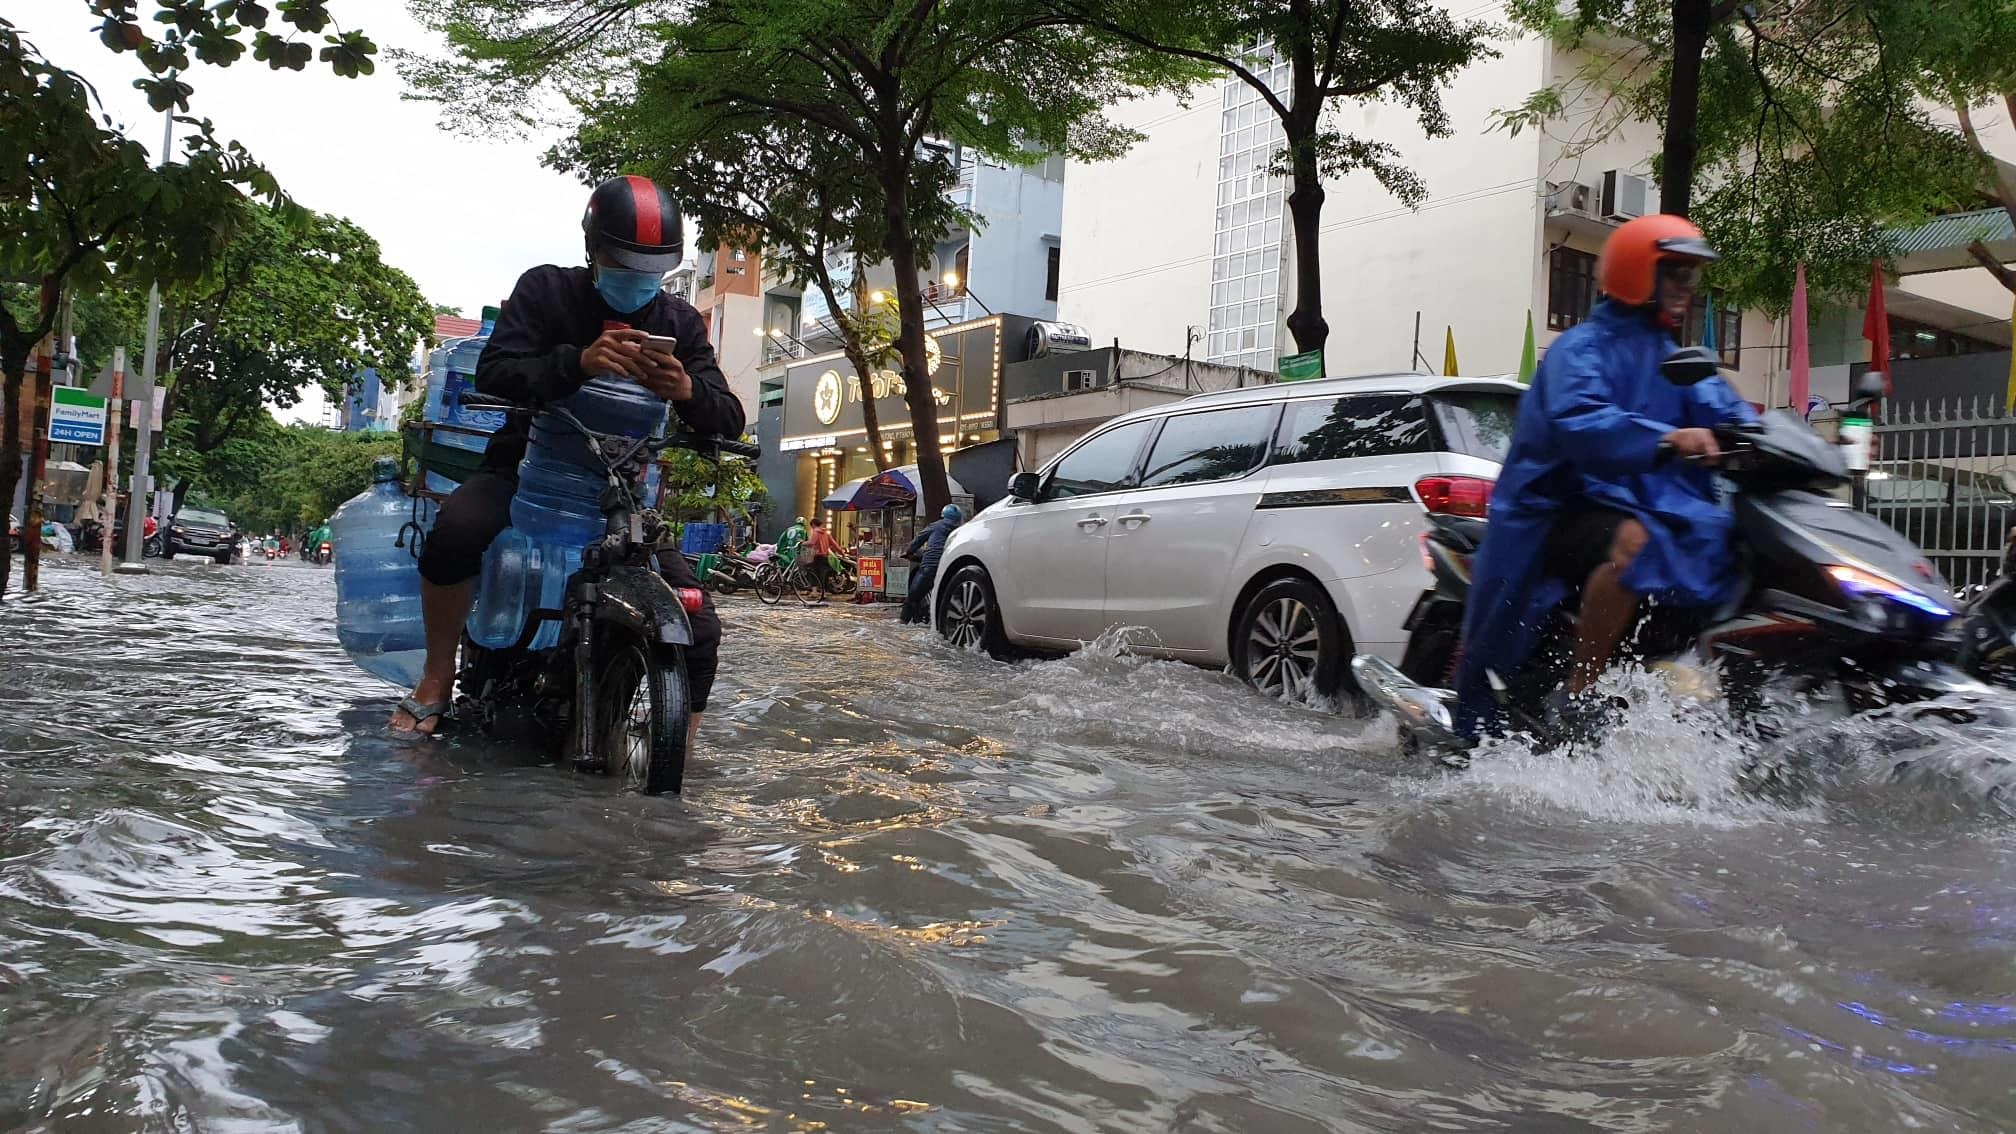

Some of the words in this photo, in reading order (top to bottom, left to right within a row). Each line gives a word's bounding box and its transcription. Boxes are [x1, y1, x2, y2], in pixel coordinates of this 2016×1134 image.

[55, 408, 100, 419] FamilyMart
[54, 428, 72, 437] 24H
[74, 430, 98, 440] OPEN
